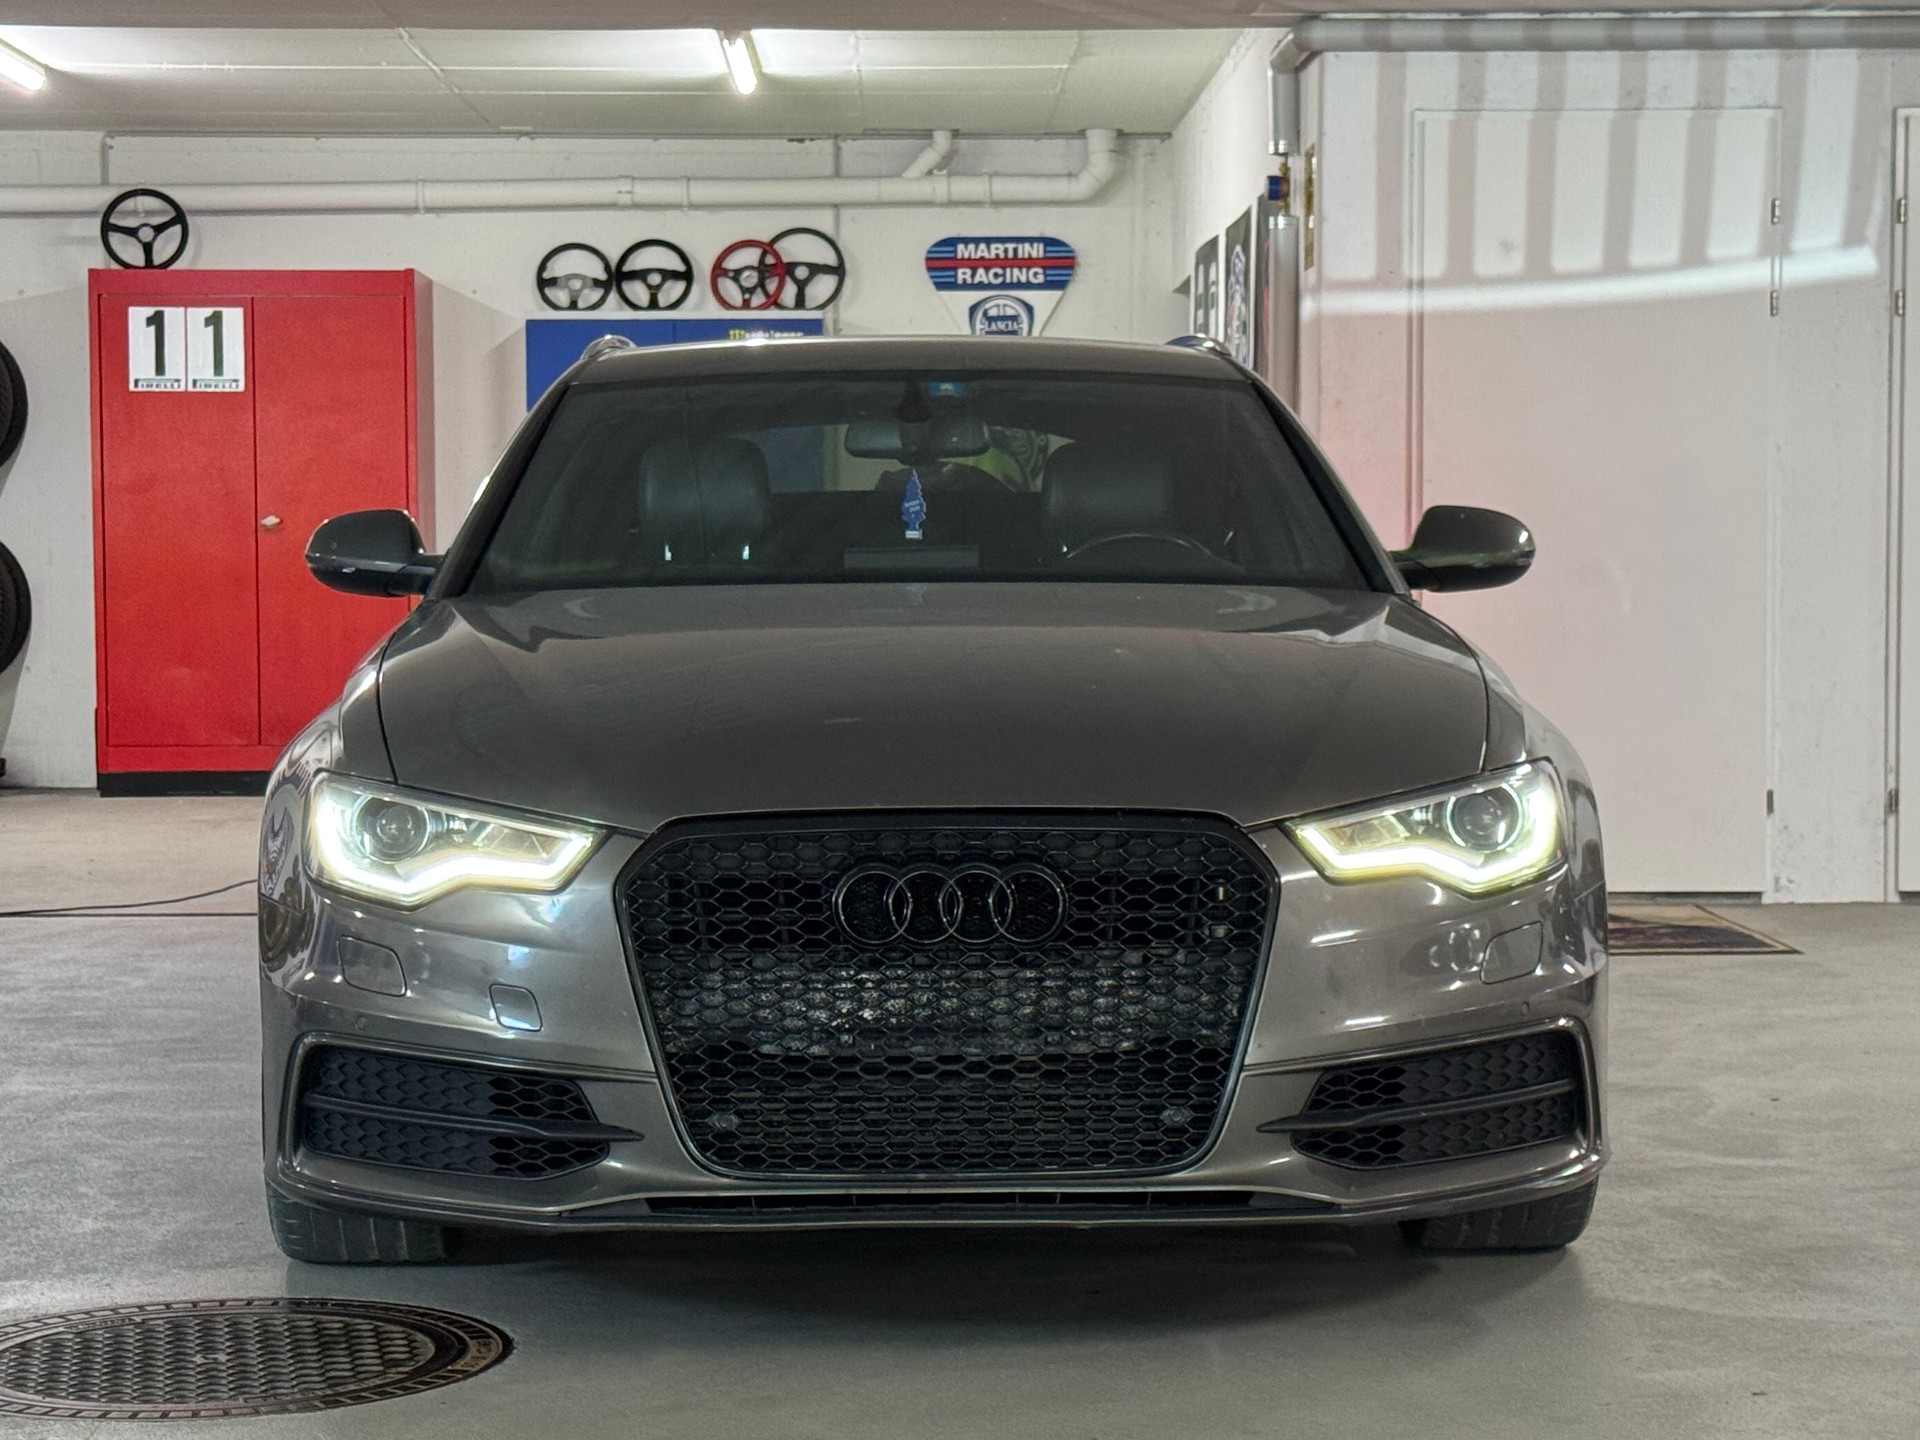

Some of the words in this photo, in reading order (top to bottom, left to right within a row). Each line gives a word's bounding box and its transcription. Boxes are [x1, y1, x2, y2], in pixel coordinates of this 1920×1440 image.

[956, 242, 1044, 259] MARTINI
[957, 268, 1045, 284] RACING
[984, 320, 1019, 331] LANCIA
